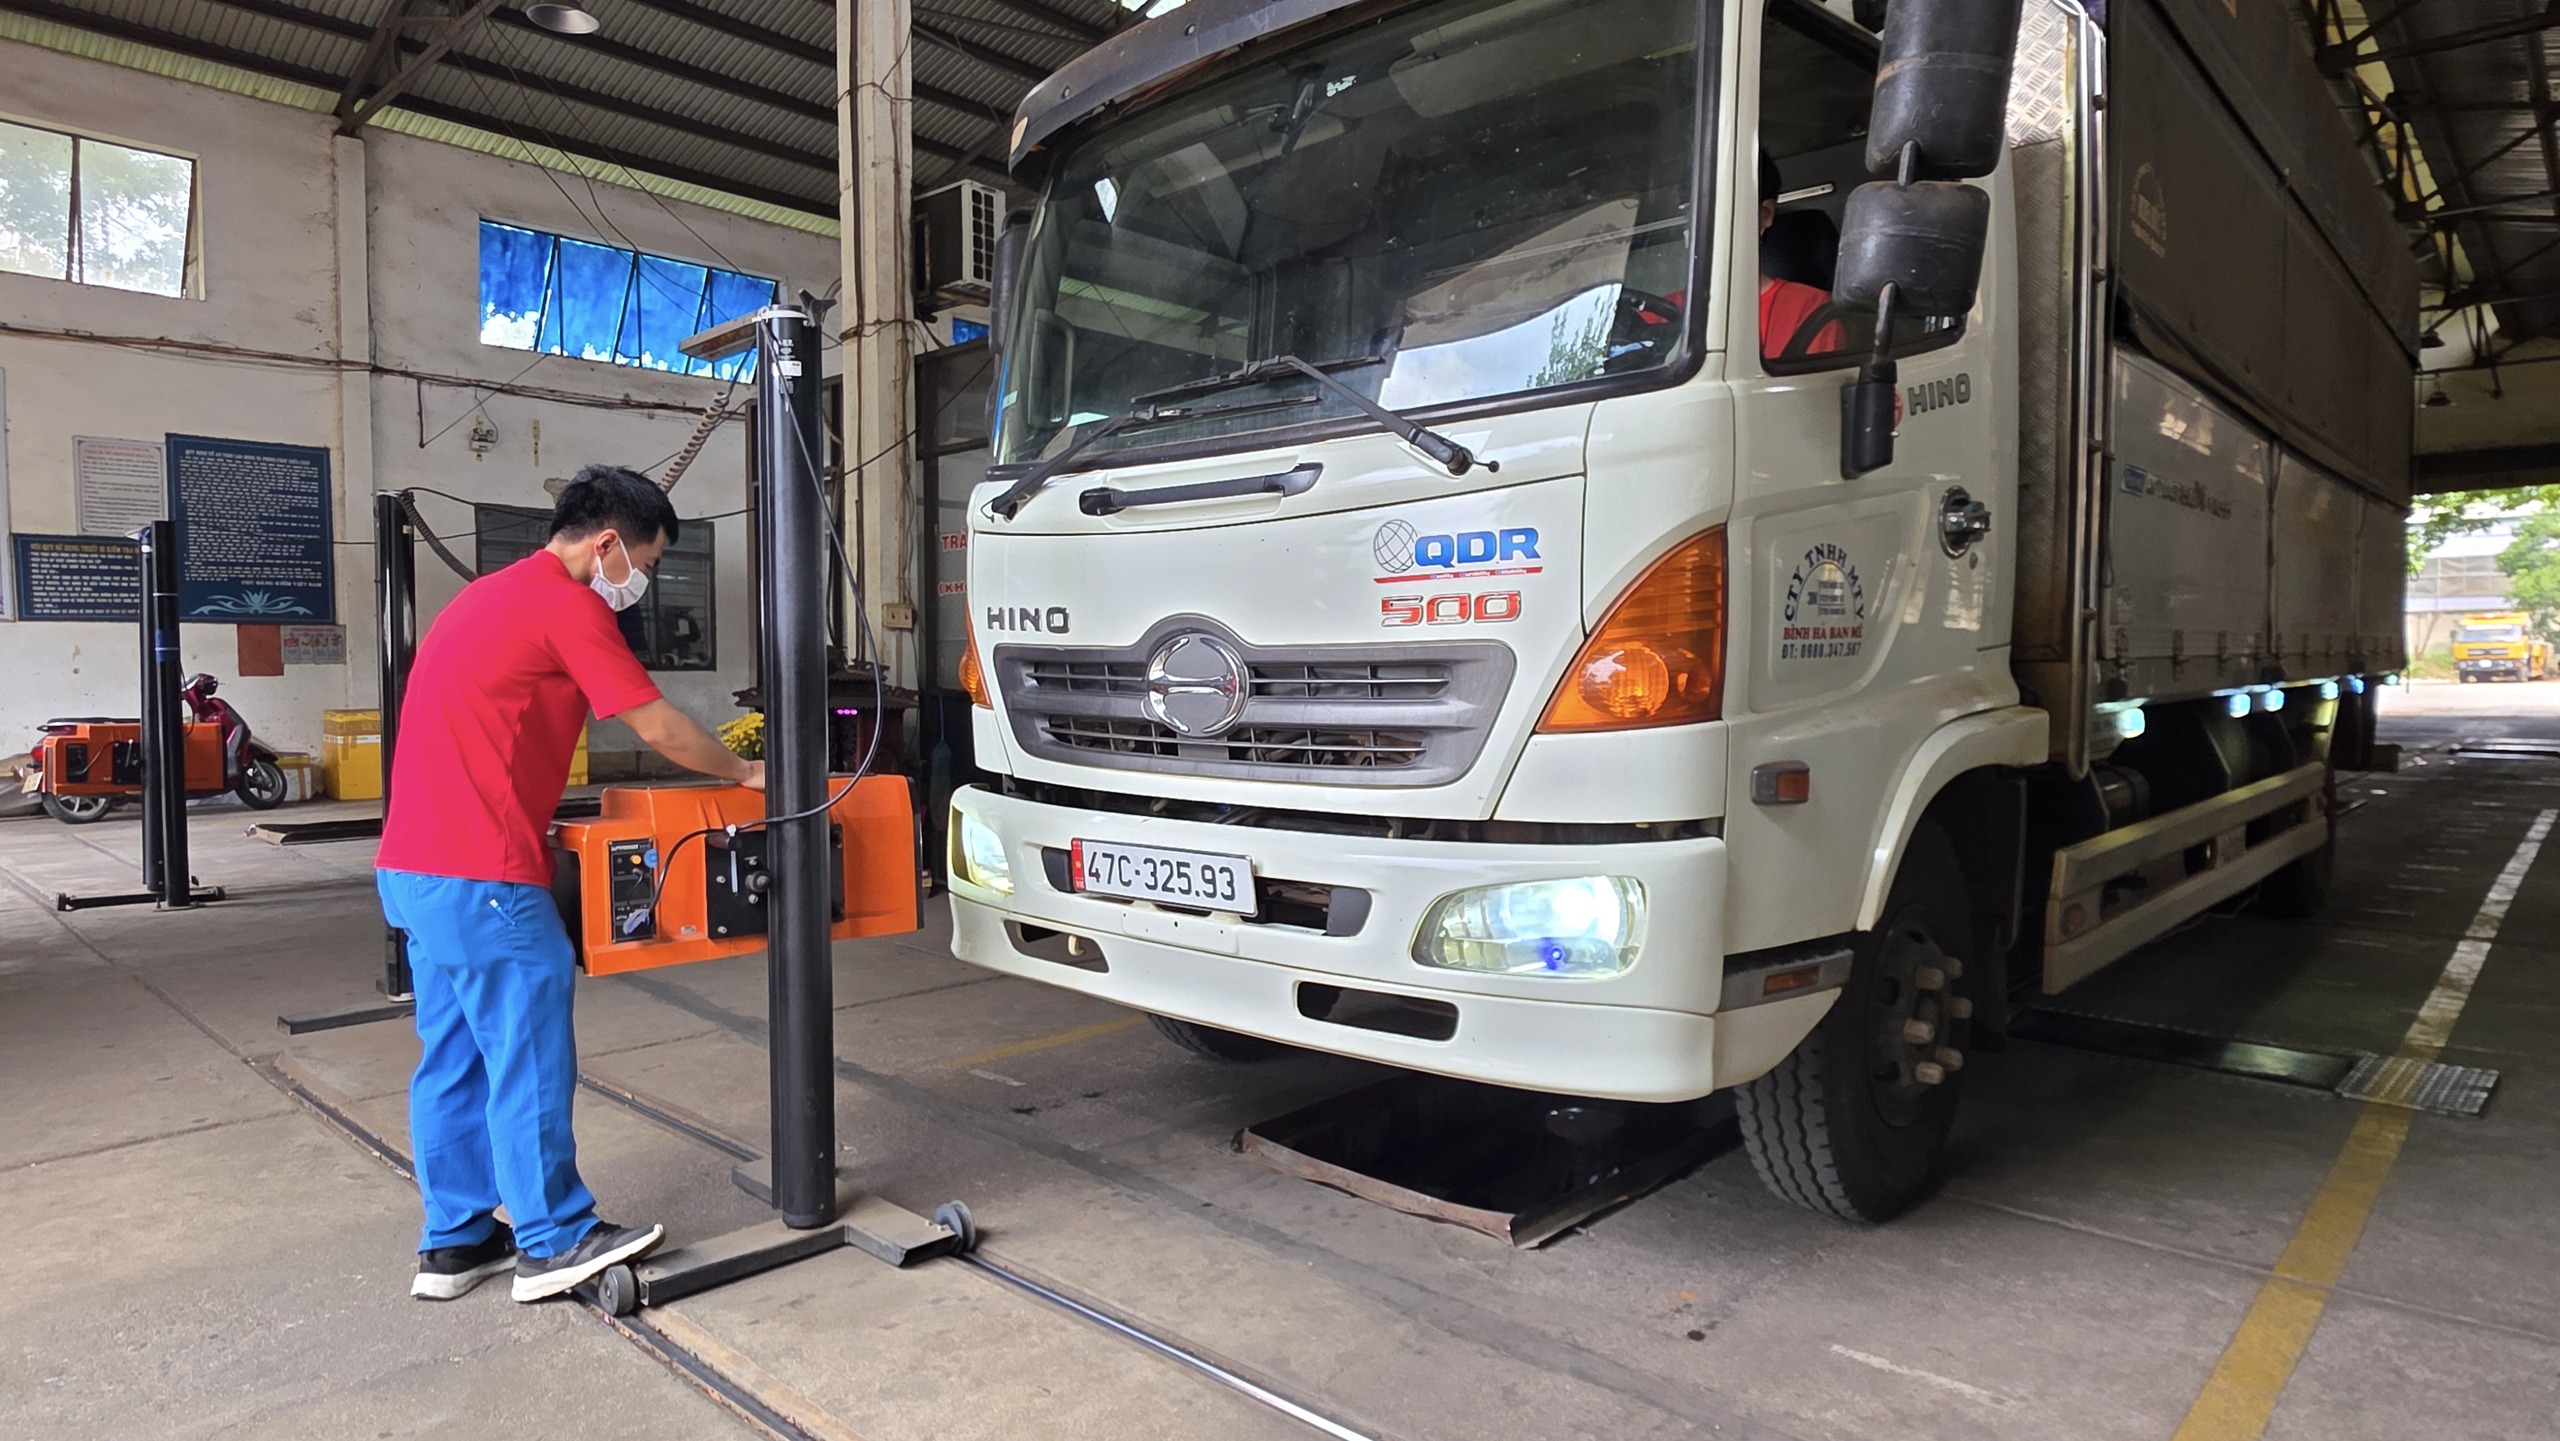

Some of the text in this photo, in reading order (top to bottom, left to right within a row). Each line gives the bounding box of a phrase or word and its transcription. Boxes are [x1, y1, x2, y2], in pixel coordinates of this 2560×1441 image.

[1907, 373, 1971, 416] HINO
[1414, 527, 1541, 569] QDR
[1804, 543, 1847, 569] TNHH
[938, 581, 968, 597] (KH
[987, 606, 1071, 634] HINO
[1381, 590, 1522, 627] 500
[1088, 851, 1236, 901] 47C-325.93
